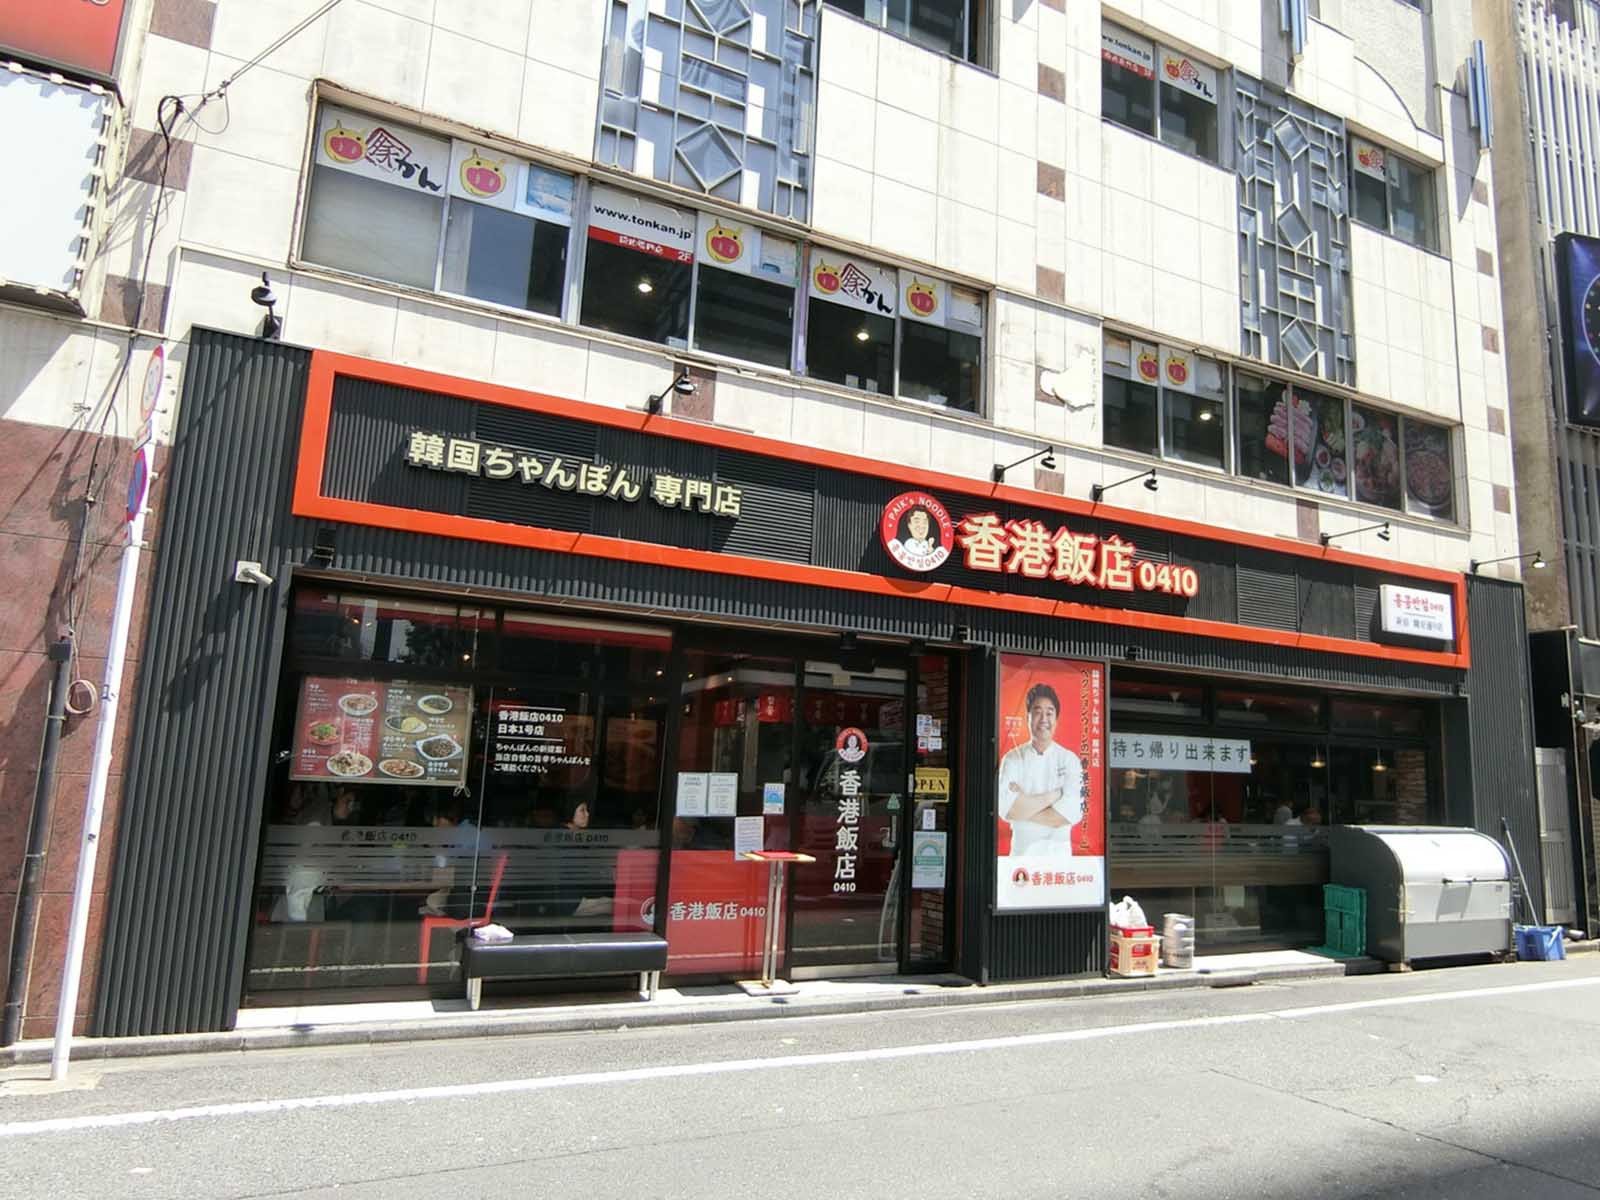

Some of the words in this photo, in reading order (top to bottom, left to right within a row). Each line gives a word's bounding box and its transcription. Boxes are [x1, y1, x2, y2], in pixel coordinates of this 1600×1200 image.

[366, 128, 443, 192] 豚かん
[594, 204, 692, 240] www.tonkan.jp
[407, 431, 641, 499] 韓国ちゃんぽん
[653, 473, 742, 516] 専門店
[918, 496, 951, 529] NOODLE
[959, 514, 1136, 590] 香港飯店
[1139, 561, 1199, 596] 0410
[497, 723, 545, 736] 日本1号店
[1111, 737, 1248, 762] 持ち帰り出来ます
[915, 779, 946, 790] PEN
[834, 769, 862, 879] 香港飯店
[833, 882, 856, 892] 0410
[1031, 871, 1076, 886] 香港飯店
[670, 901, 739, 920] 香港飯店
[740, 907, 766, 918] 0410
